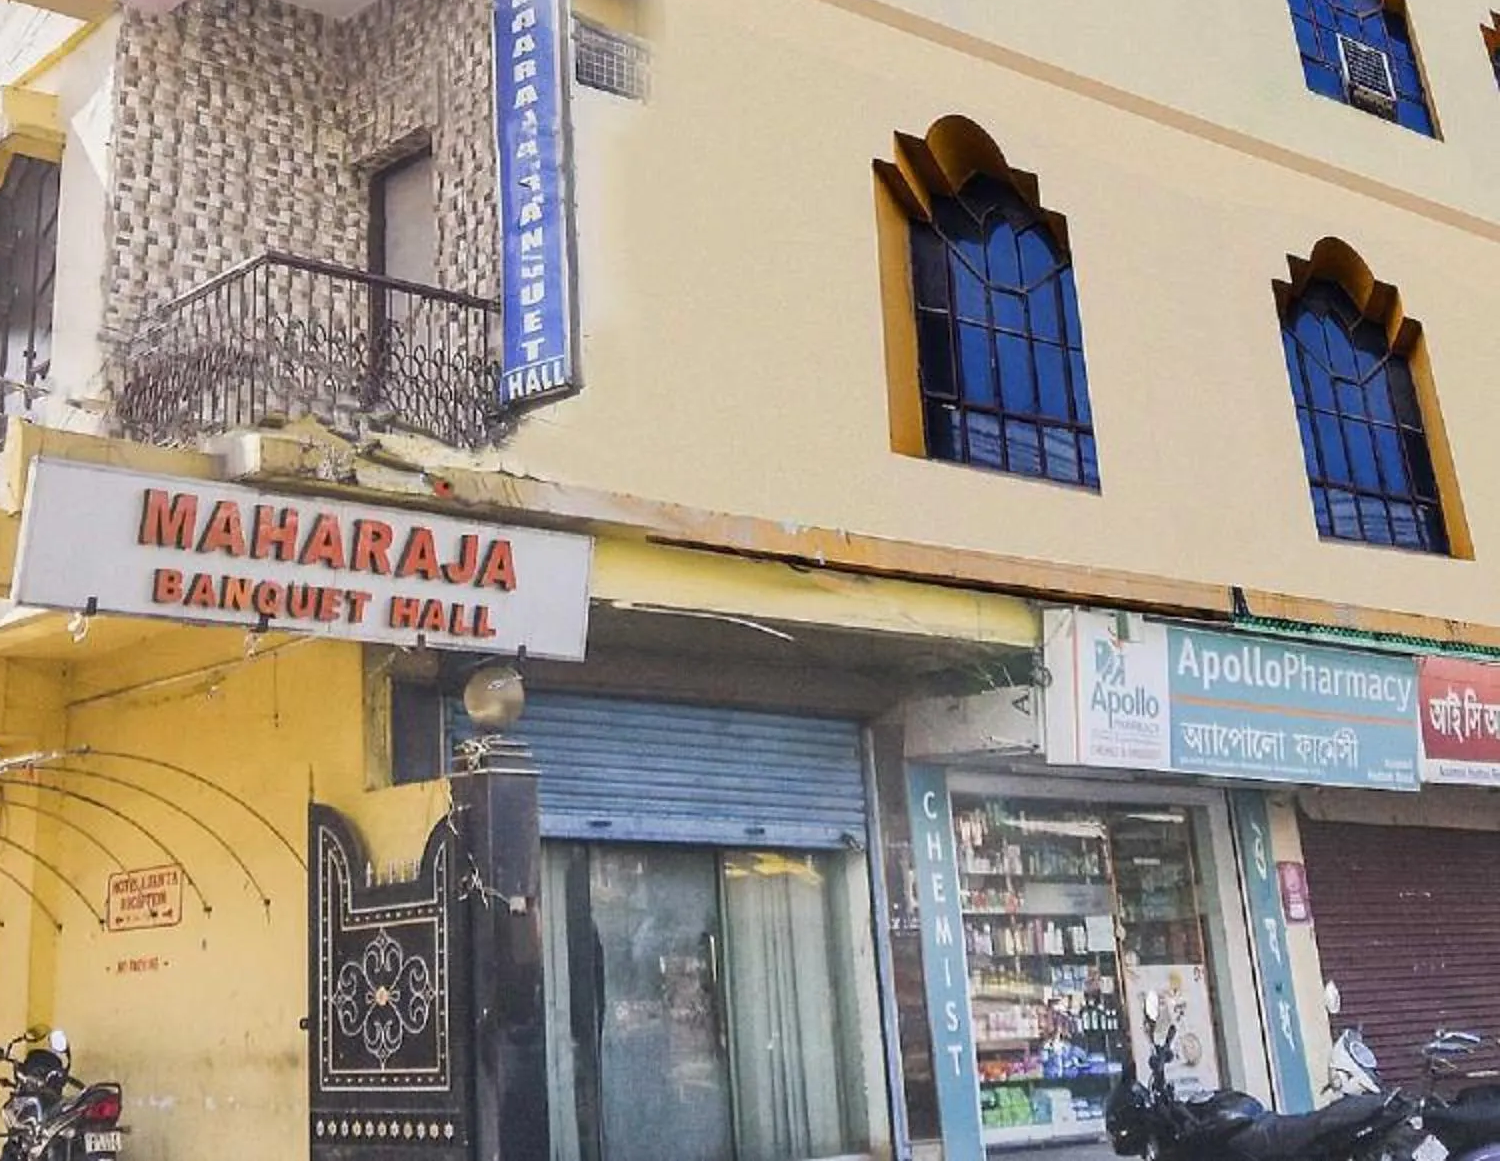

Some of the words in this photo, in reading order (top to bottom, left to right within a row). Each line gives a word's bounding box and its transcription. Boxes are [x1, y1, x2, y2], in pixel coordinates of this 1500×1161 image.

[508, 359, 565, 400] HALL
[137, 487, 518, 592] MAHARAJA
[151, 567, 373, 627] BANQUET
[388, 595, 497, 638] HALL
[1091, 681, 1160, 729] Apollo
[923, 791, 962, 1076] CHEMIST
